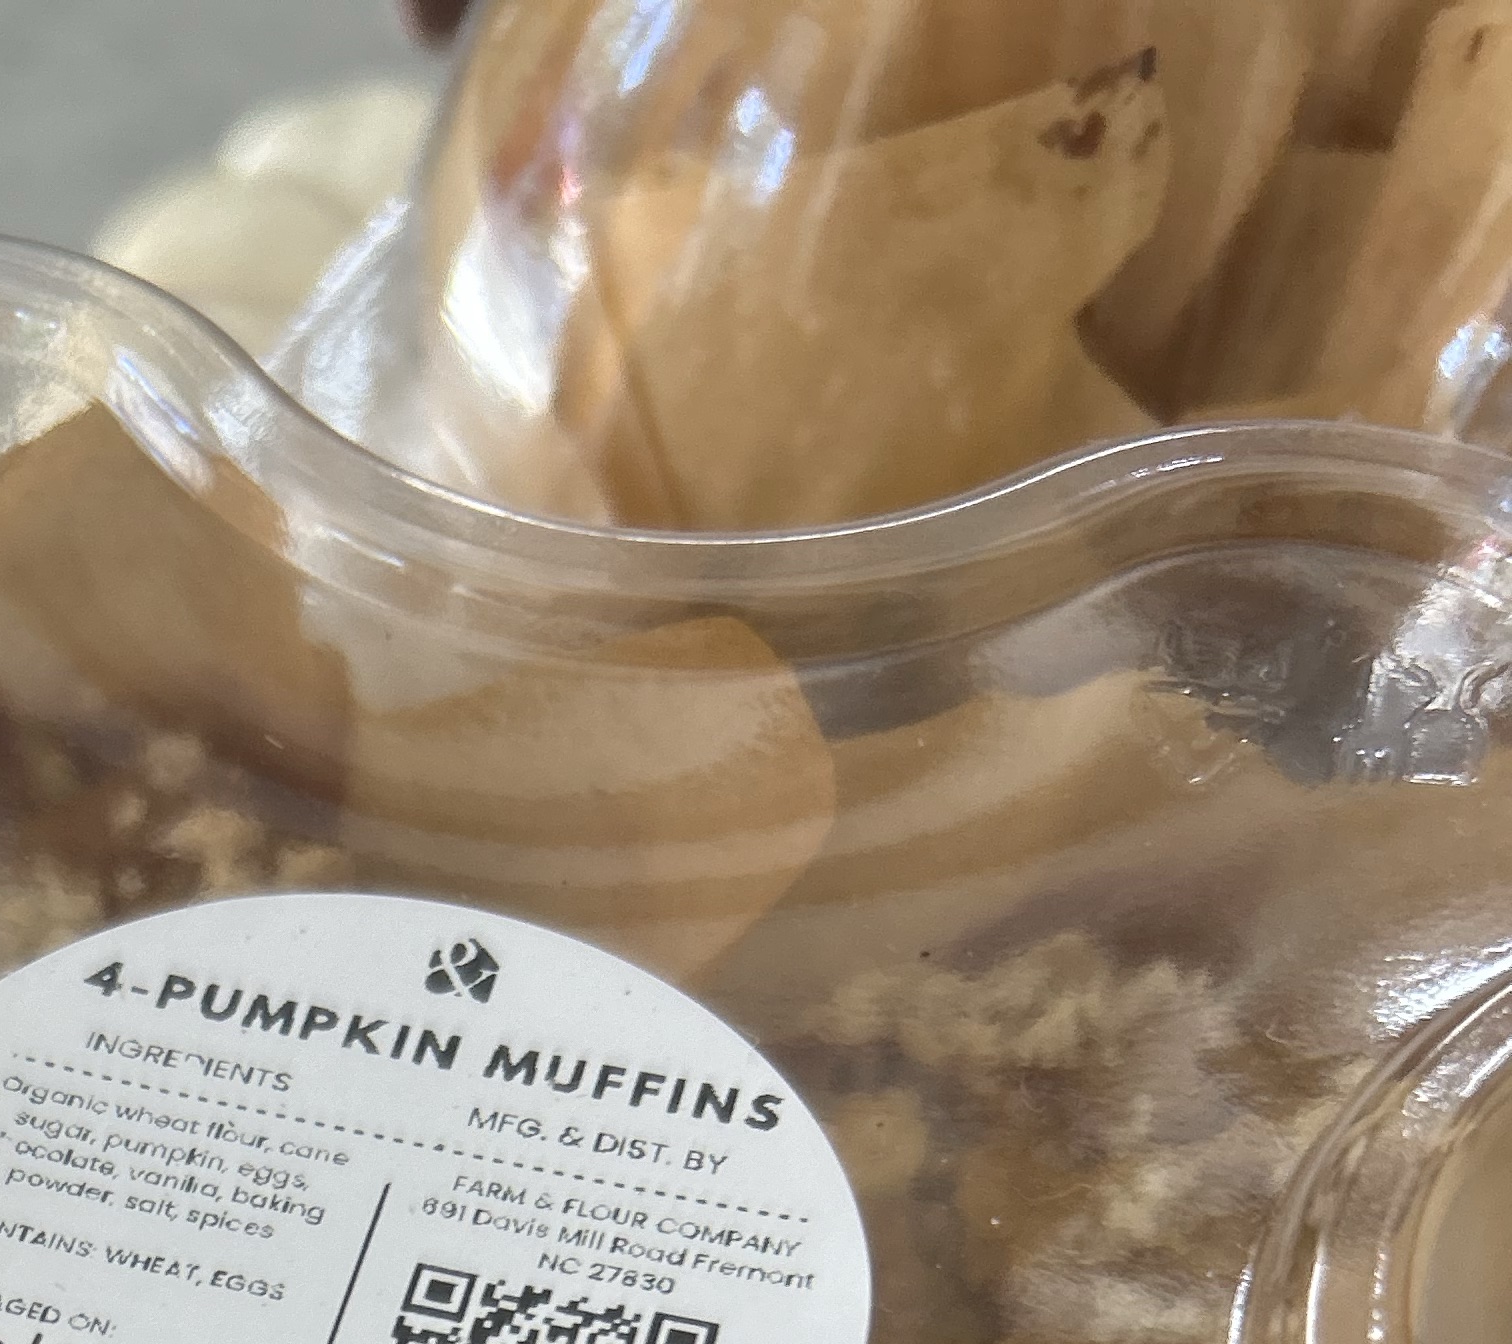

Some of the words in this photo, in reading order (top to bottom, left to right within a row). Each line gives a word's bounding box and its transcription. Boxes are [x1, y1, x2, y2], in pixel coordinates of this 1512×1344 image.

[84, 961, 462, 1070] 4-PUMPKIN
[486, 1043, 786, 1132] MUFFINS
[2, 1075, 109, 1116] Organic
[115, 1102, 200, 1136] wheat
[207, 1121, 273, 1152] flour,
[279, 1140, 350, 1167] cane
[13, 1110, 97, 1146] sugar,
[102, 1133, 229, 1175] pumpkin,
[238, 1161, 309, 1192] eggs,
[467, 1107, 547, 1142] MFG.
[558, 1126, 583, 1148] &
[593, 1131, 672, 1166] DIST.
[683, 1149, 728, 1176] BY
[125, 1193, 178, 1223] salt,
[186, 1206, 275, 1240] spices
[129, 1166, 224, 1203] vanilla,
[232, 1185, 326, 1226] baking
[452, 1175, 526, 1206] FARM
[534, 1192, 555, 1211] &
[561, 1198, 648, 1231] FLOUR
[655, 1216, 802, 1258] COMPANY
[105, 1245, 203, 1287] WHEAT,
[209, 1270, 287, 1302] EGGS
[472, 1207, 550, 1240] Davis
[556, 1225, 605, 1252] Mill
[608, 1235, 686, 1268] Road
[691, 1251, 816, 1291] Fremont
[537, 1252, 581, 1276] NC
[68, 1312, 117, 1338] ON:
